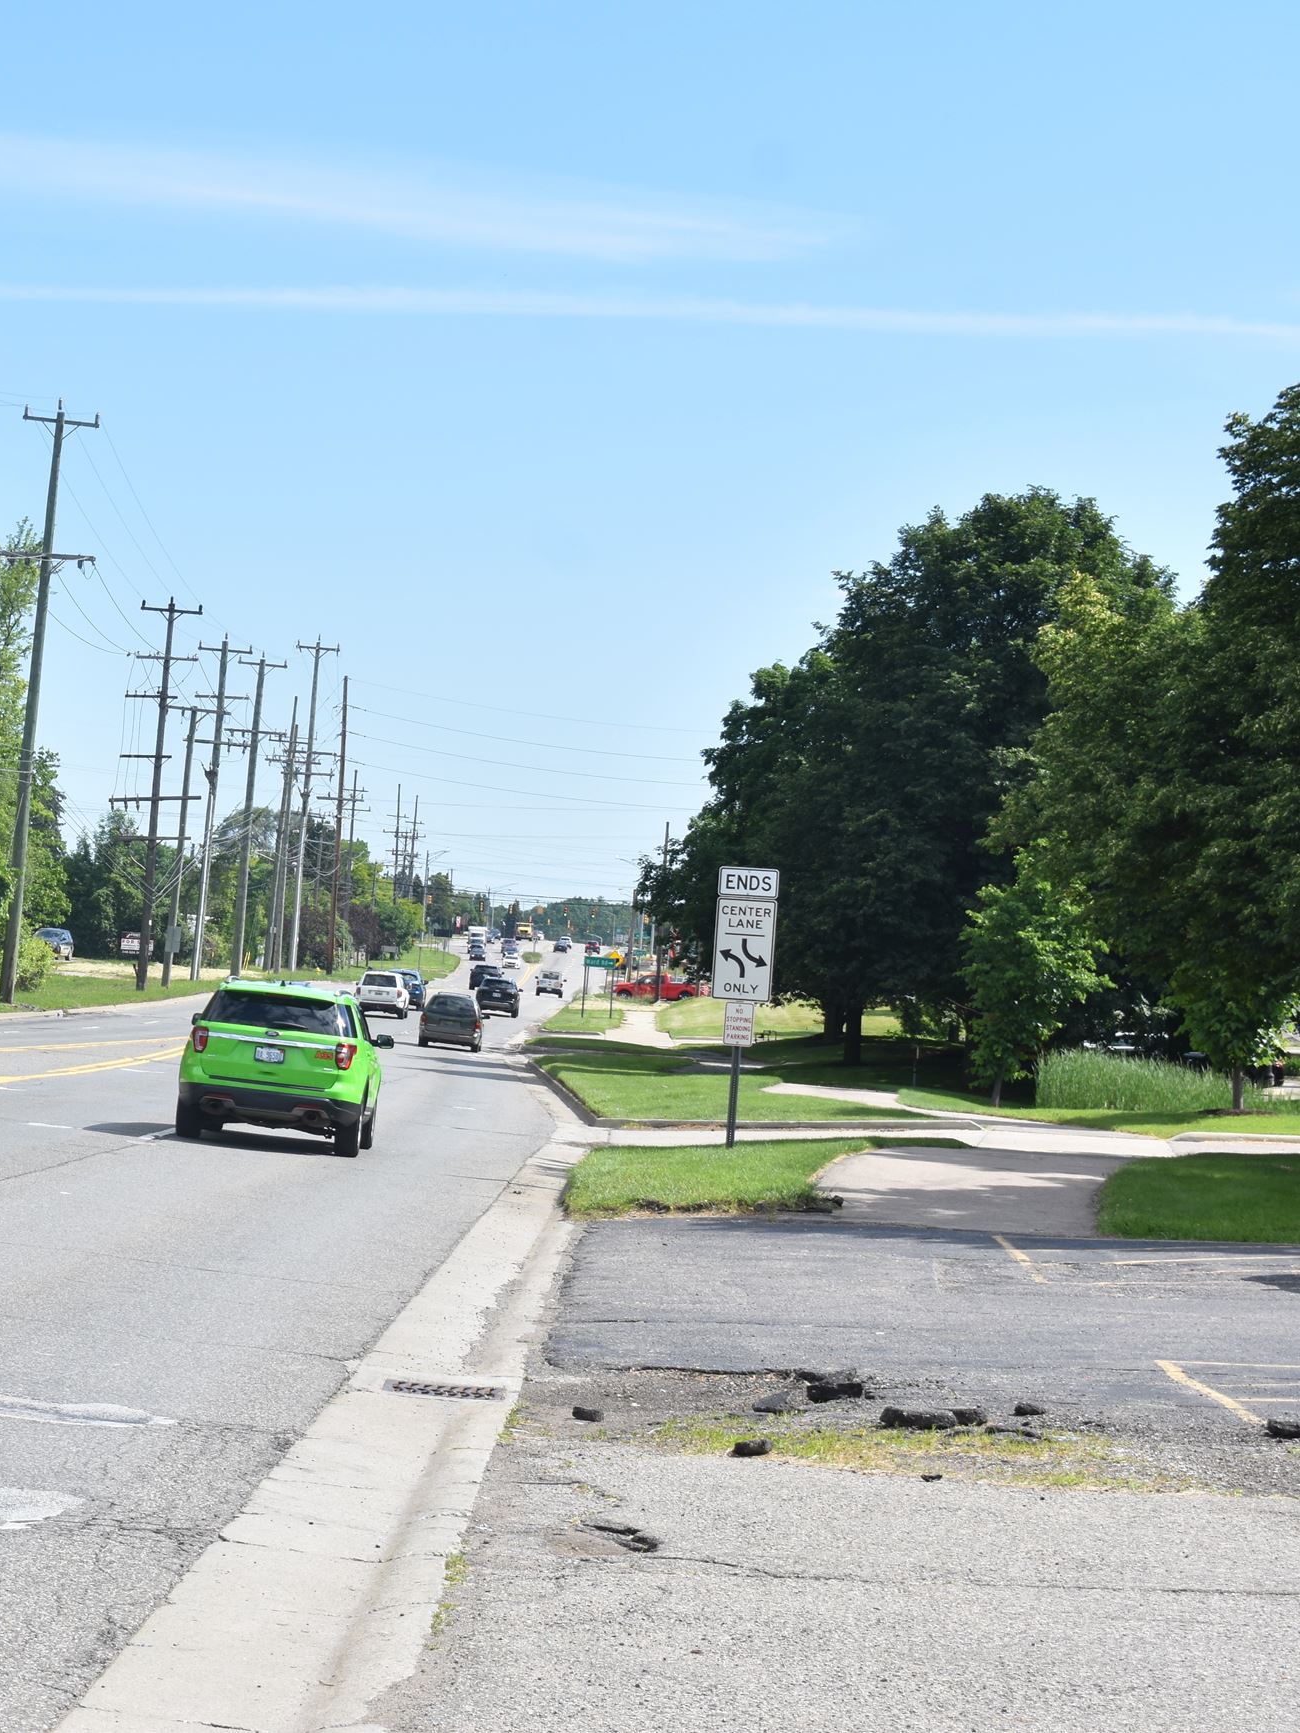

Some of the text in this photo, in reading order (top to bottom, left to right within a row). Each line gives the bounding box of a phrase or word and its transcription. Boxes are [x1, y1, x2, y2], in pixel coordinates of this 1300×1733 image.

[725, 874, 772, 891] ENDS
[721, 905, 771, 918] CENTER
[728, 918, 763, 930] LANE
[723, 982, 759, 994] ONLY
[726, 1016, 752, 1024] STOPPING
[725, 1024, 751, 1032] STANDING
[726, 1033, 749, 1041] PARKING
